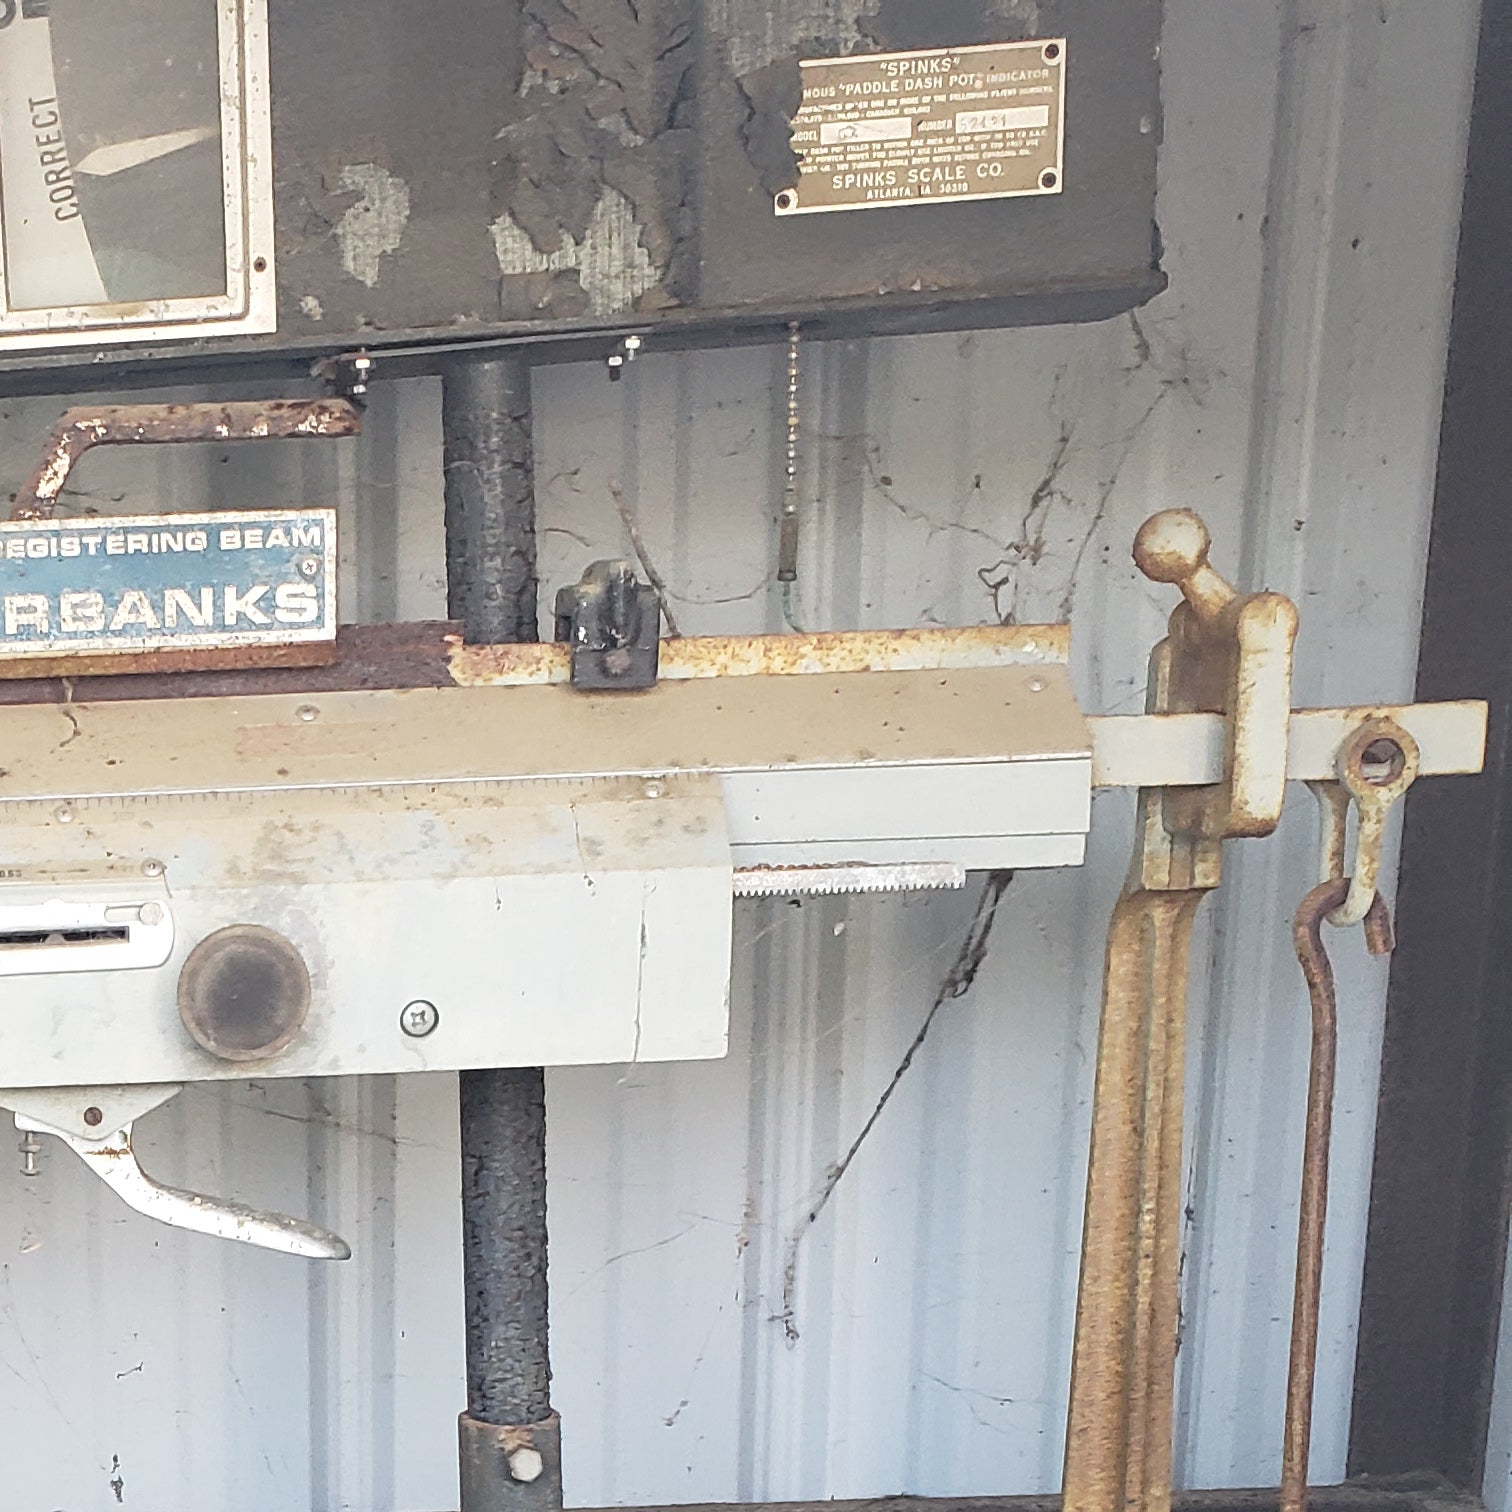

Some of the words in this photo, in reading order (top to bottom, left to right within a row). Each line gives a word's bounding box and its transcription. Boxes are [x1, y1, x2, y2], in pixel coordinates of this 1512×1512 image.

[905, 76, 943, 91] DASH
[986, 68, 1049, 83] INDICATOR
[28, 97, 82, 222] CORRECT
[832, 170, 896, 189] SPINKS
[907, 165, 966, 184] SCALE
[976, 162, 1005, 178] CO.
[220, 526, 322, 550] BEAM
